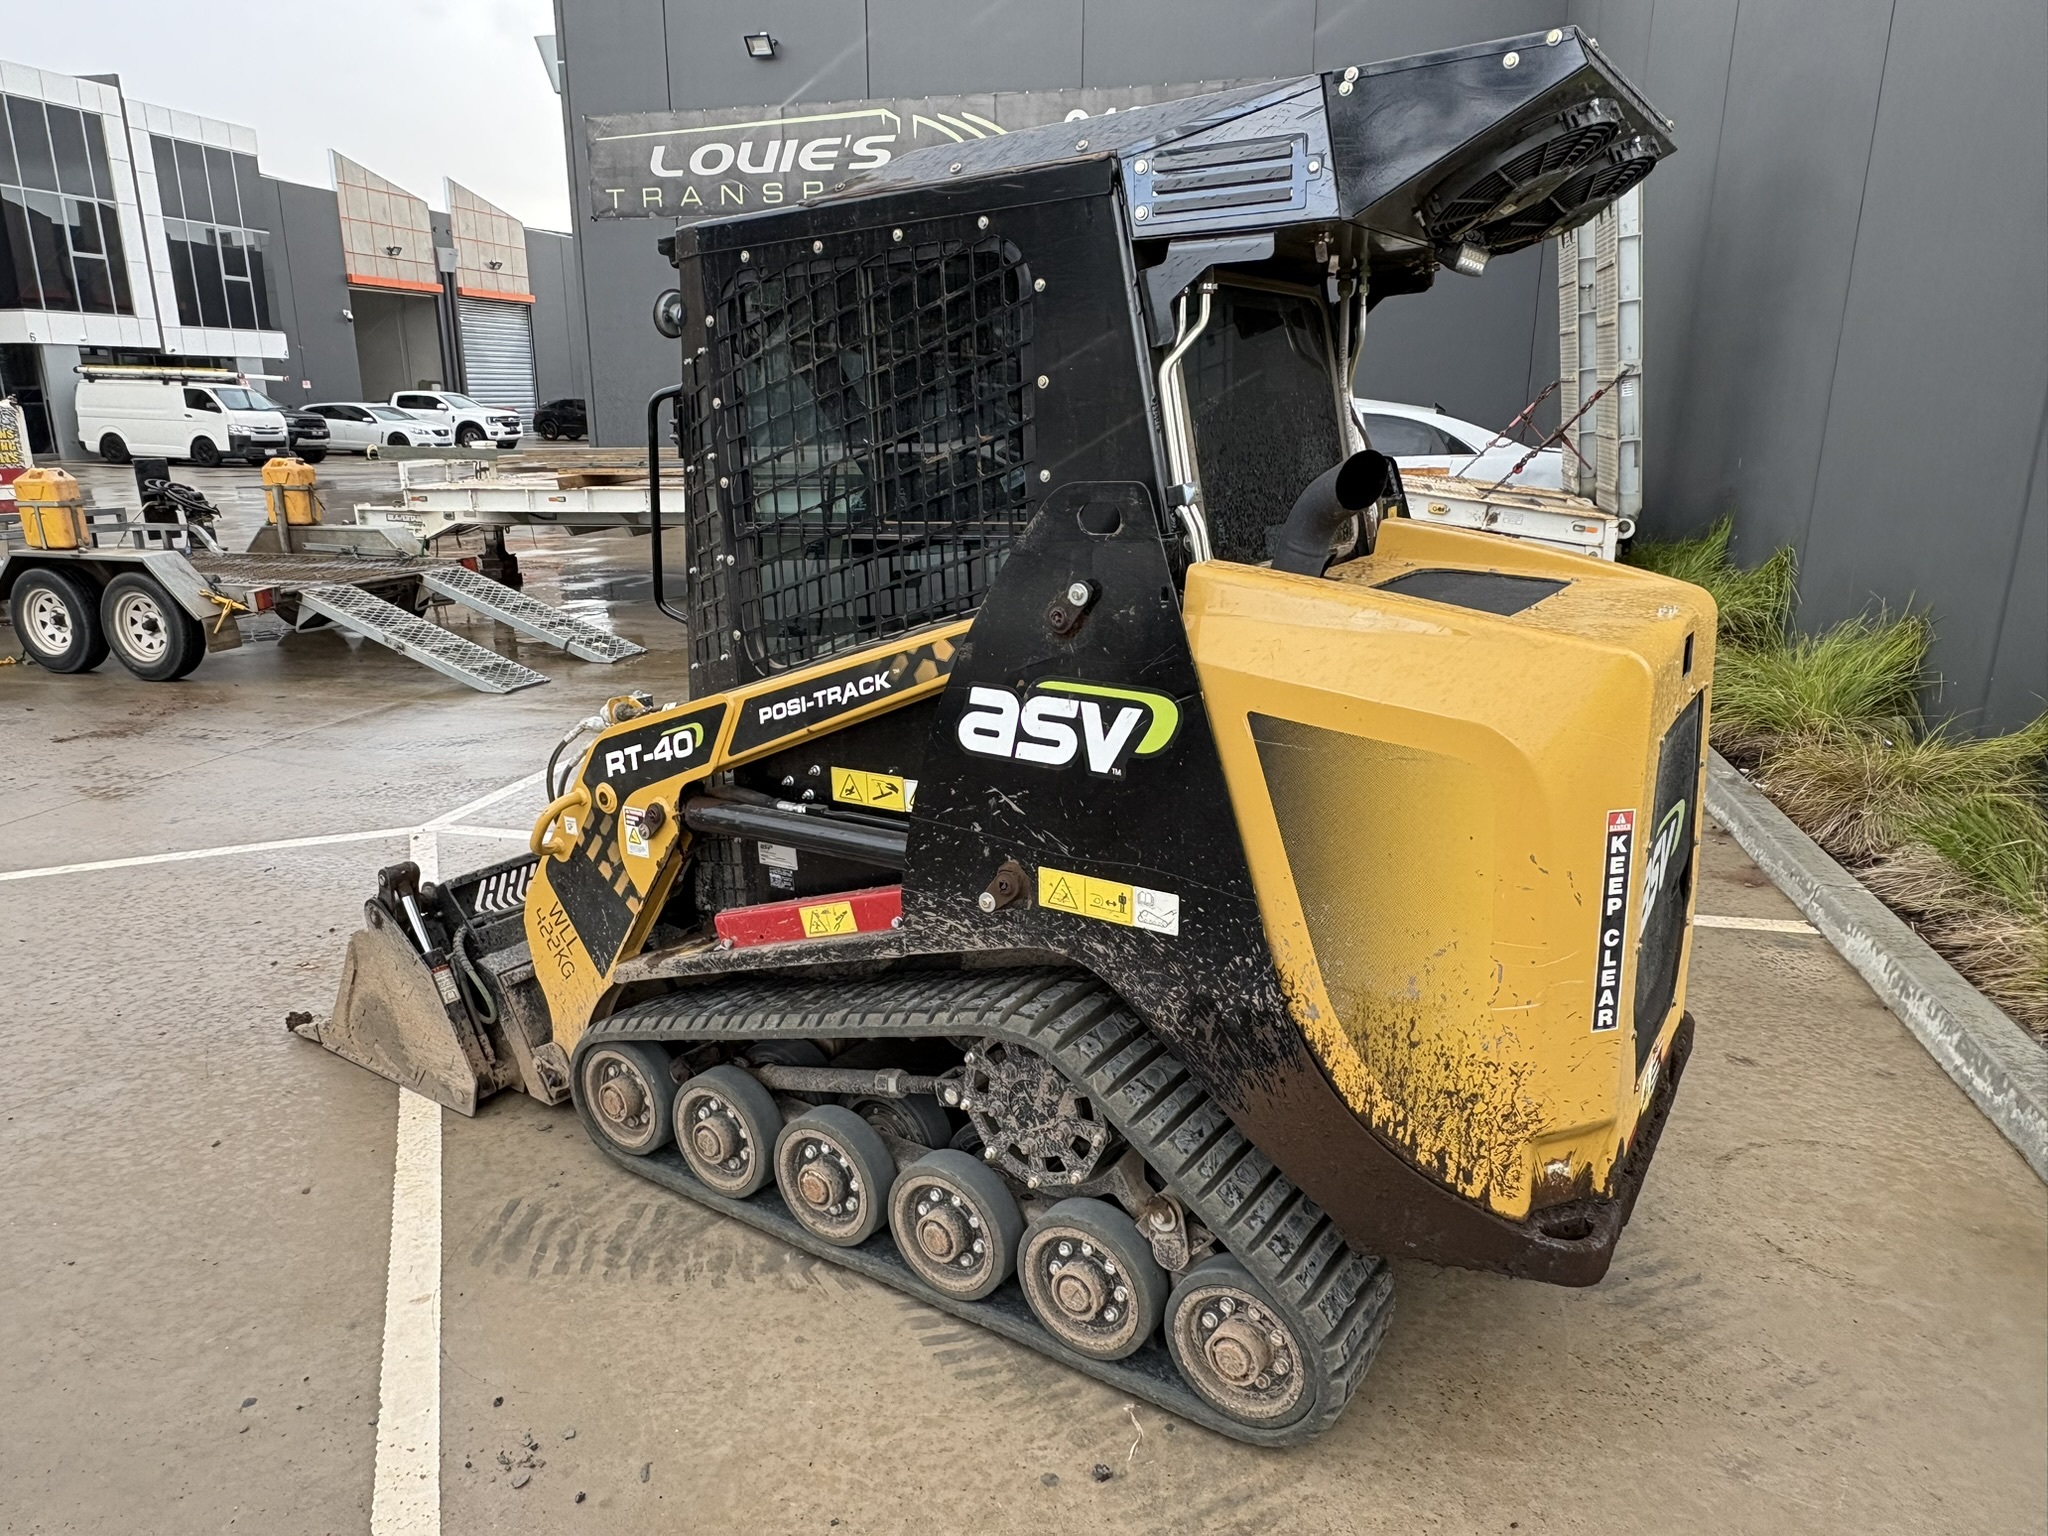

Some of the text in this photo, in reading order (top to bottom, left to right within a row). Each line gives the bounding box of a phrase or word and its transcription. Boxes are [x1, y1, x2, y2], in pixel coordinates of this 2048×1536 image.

[650, 134, 896, 178] LOUIE'S
[605, 181, 824, 209] TRANSP
[29, 332, 37, 342] 6
[758, 670, 892, 725] POSI-TRACK
[605, 729, 694, 778] RT-40
[549, 901, 578, 956] WLL
[1597, 834, 1628, 1027] KEEP CLEAR
